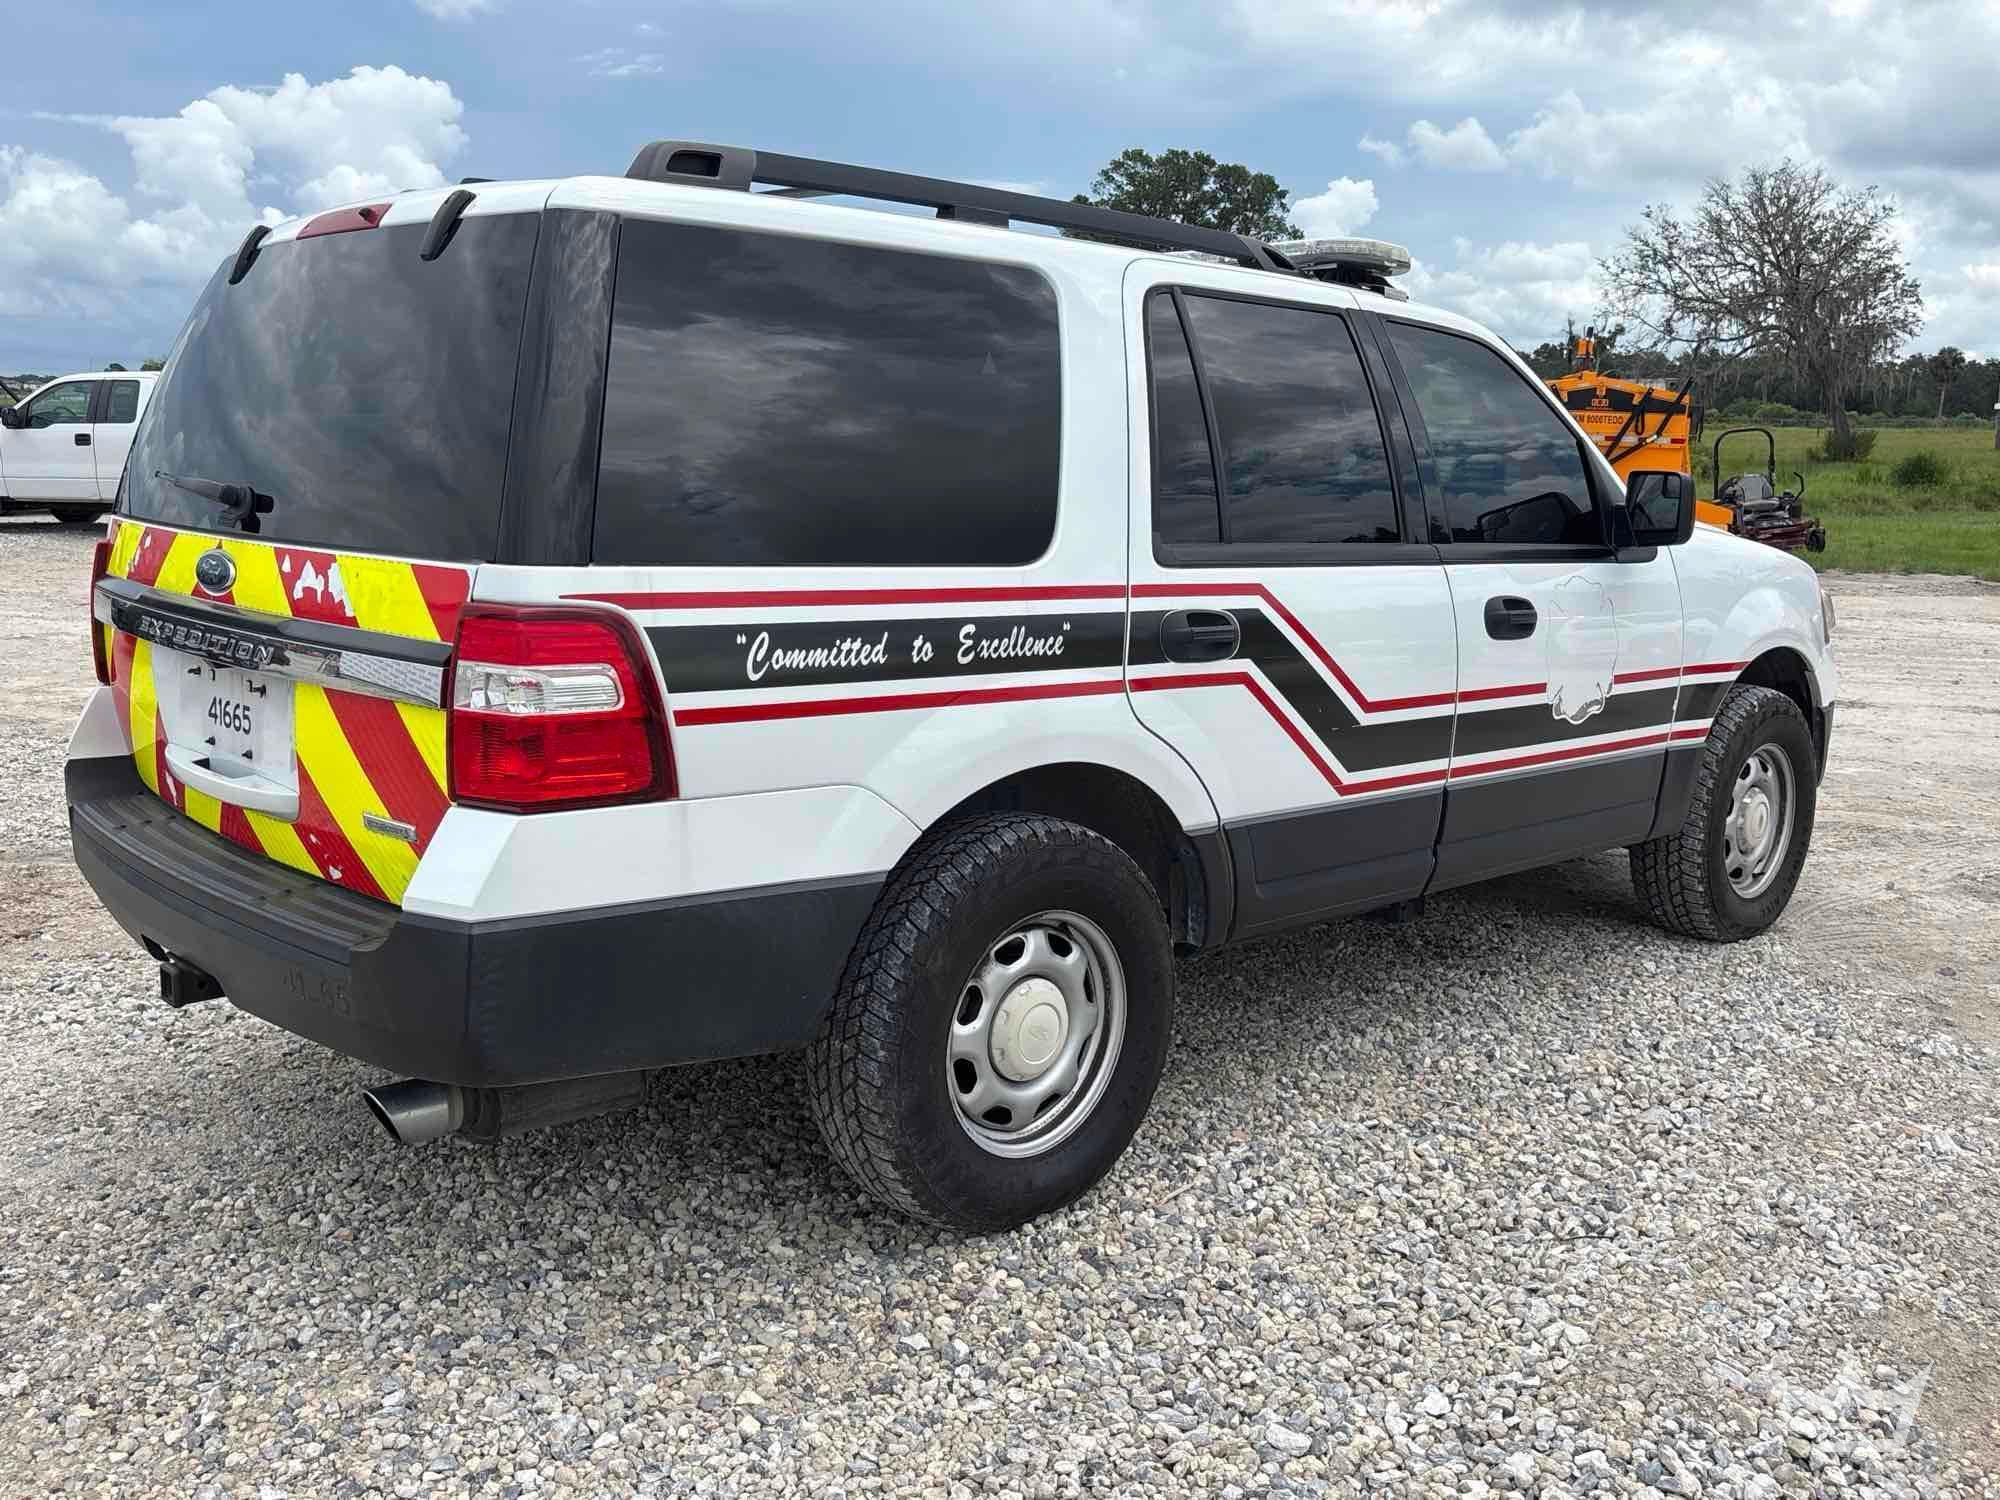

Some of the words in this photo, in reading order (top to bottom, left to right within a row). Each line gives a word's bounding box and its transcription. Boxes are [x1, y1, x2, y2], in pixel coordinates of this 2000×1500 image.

[138, 614, 275, 665] EXPEDITION
[736, 631, 888, 682] "Committed
[912, 634, 934, 663] to
[207, 696, 252, 736] 41665
